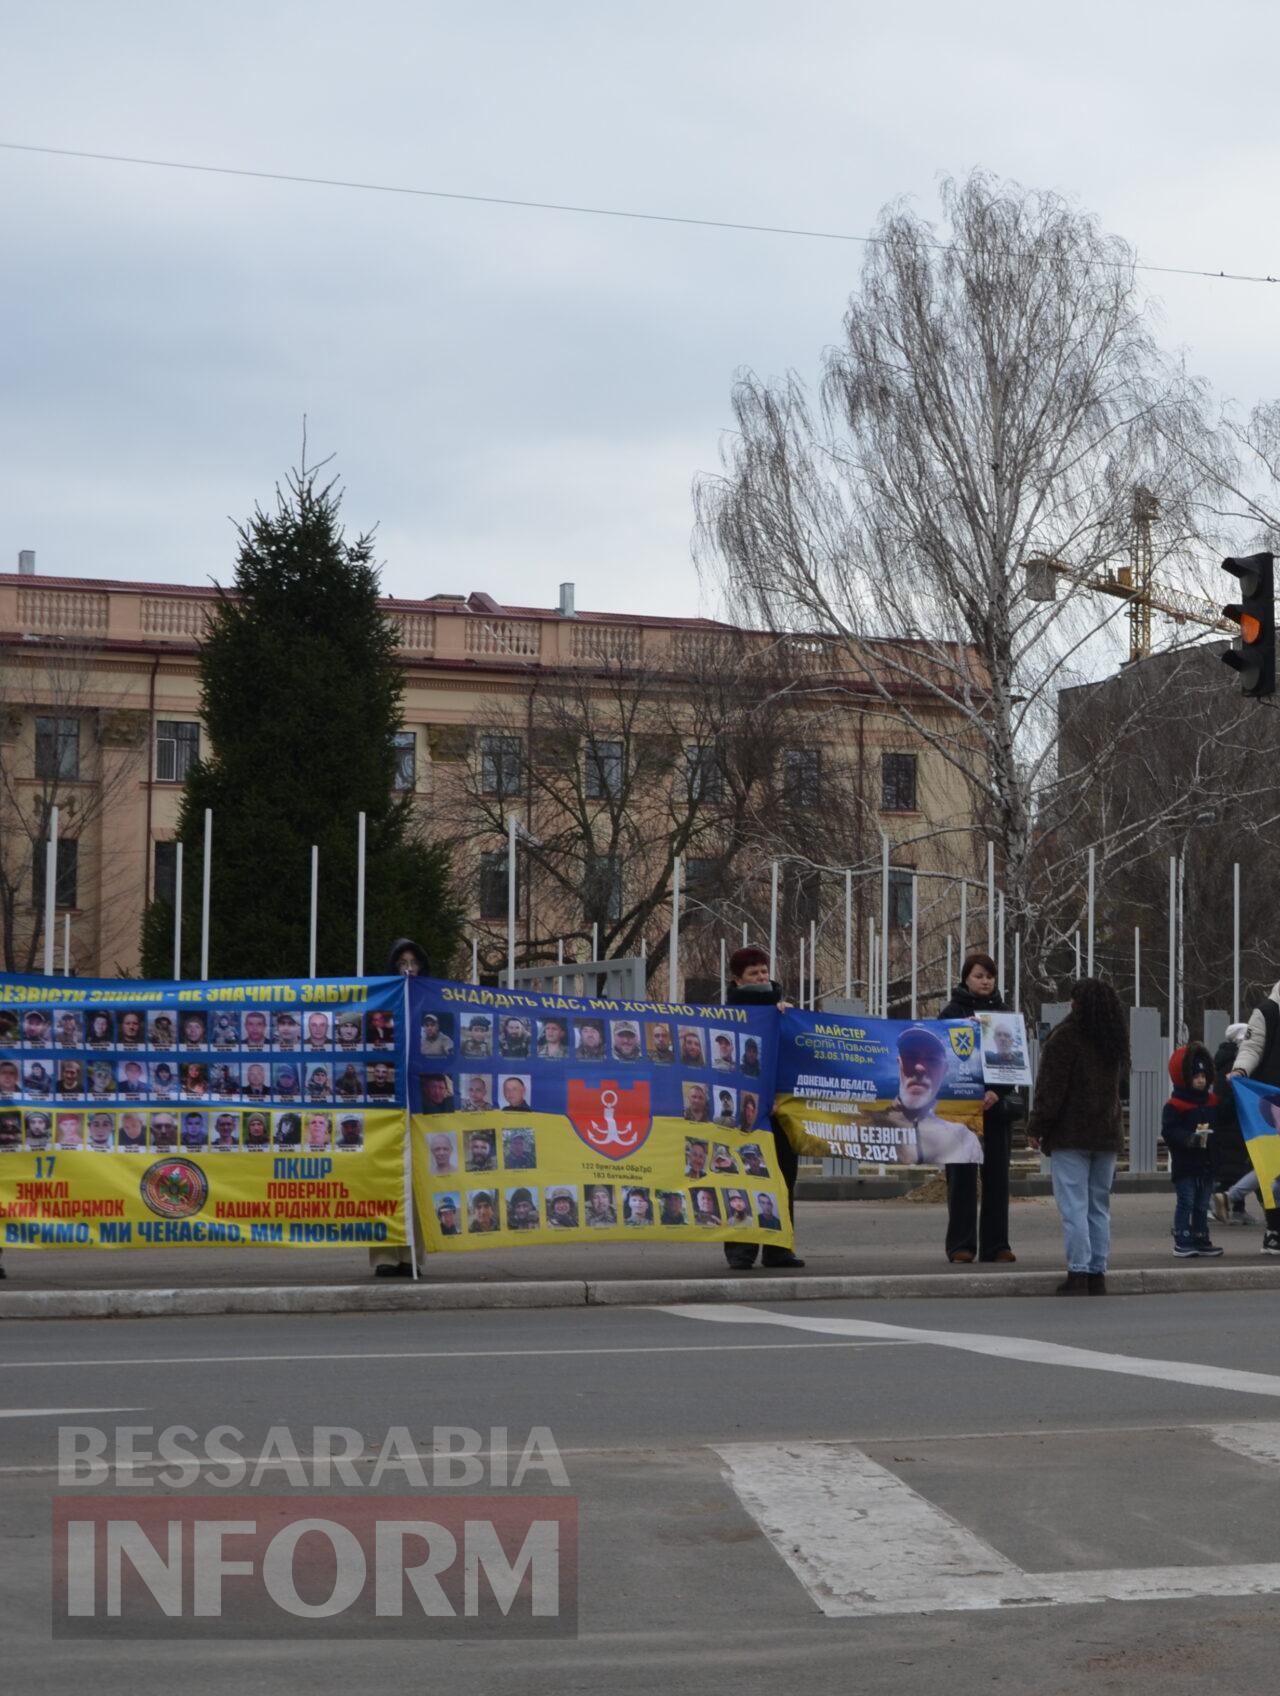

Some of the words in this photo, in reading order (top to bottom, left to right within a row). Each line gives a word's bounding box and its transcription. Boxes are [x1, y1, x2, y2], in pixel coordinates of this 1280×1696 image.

[207, 985, 297, 1002] ЗНАЧИТЬ
[301, 985, 368, 1003] ЗАБУТІ
[441, 987, 537, 1007] ЗНАЙДІТЬ
[590, 999, 617, 1011] МИ
[623, 1001, 694, 1017] ХОЧЕМО
[699, 1007, 747, 1023] ЖИТИ
[815, 1023, 866, 1039] МАЙСТЕР
[797, 1074, 840, 1088] ДОНЕЦЬКА
[860, 1127, 917, 1144] БЕЗВІСТИ
[32, 1156, 56, 1179] 17
[273, 1157, 332, 1179] ПКШР
[16, 1181, 69, 1200] ЗНИКЛІ
[267, 1182, 349, 1199] ПОВЕРНІТЬ
[42, 1200, 124, 1218] НАПРЯМОК
[215, 1201, 271, 1218] НАШИХ
[275, 1201, 330, 1219] РІДНИХ
[334, 1200, 398, 1219] ДОДОМУ
[100, 1222, 132, 1242] МИ
[250, 1223, 283, 1242] МИ
[289, 1222, 388, 1242] ЛЮБИМО
